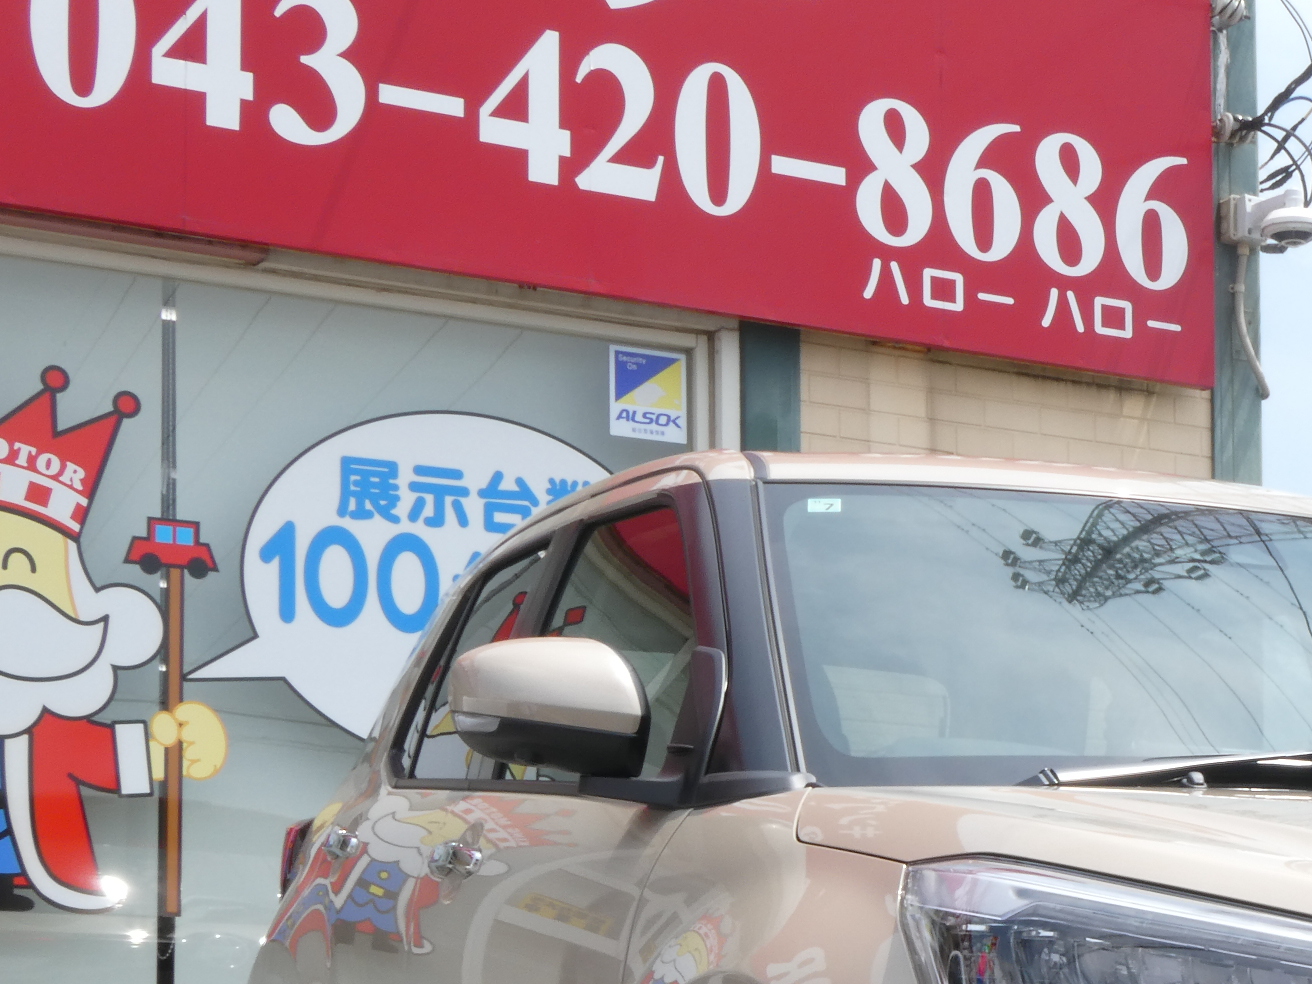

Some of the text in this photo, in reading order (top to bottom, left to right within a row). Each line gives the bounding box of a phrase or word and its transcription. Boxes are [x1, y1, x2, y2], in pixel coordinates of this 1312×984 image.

[863, 258, 1182, 339] ハロー ハロー
[615, 408, 682, 429] ALSOK
[259, 520, 484, 634] 100
